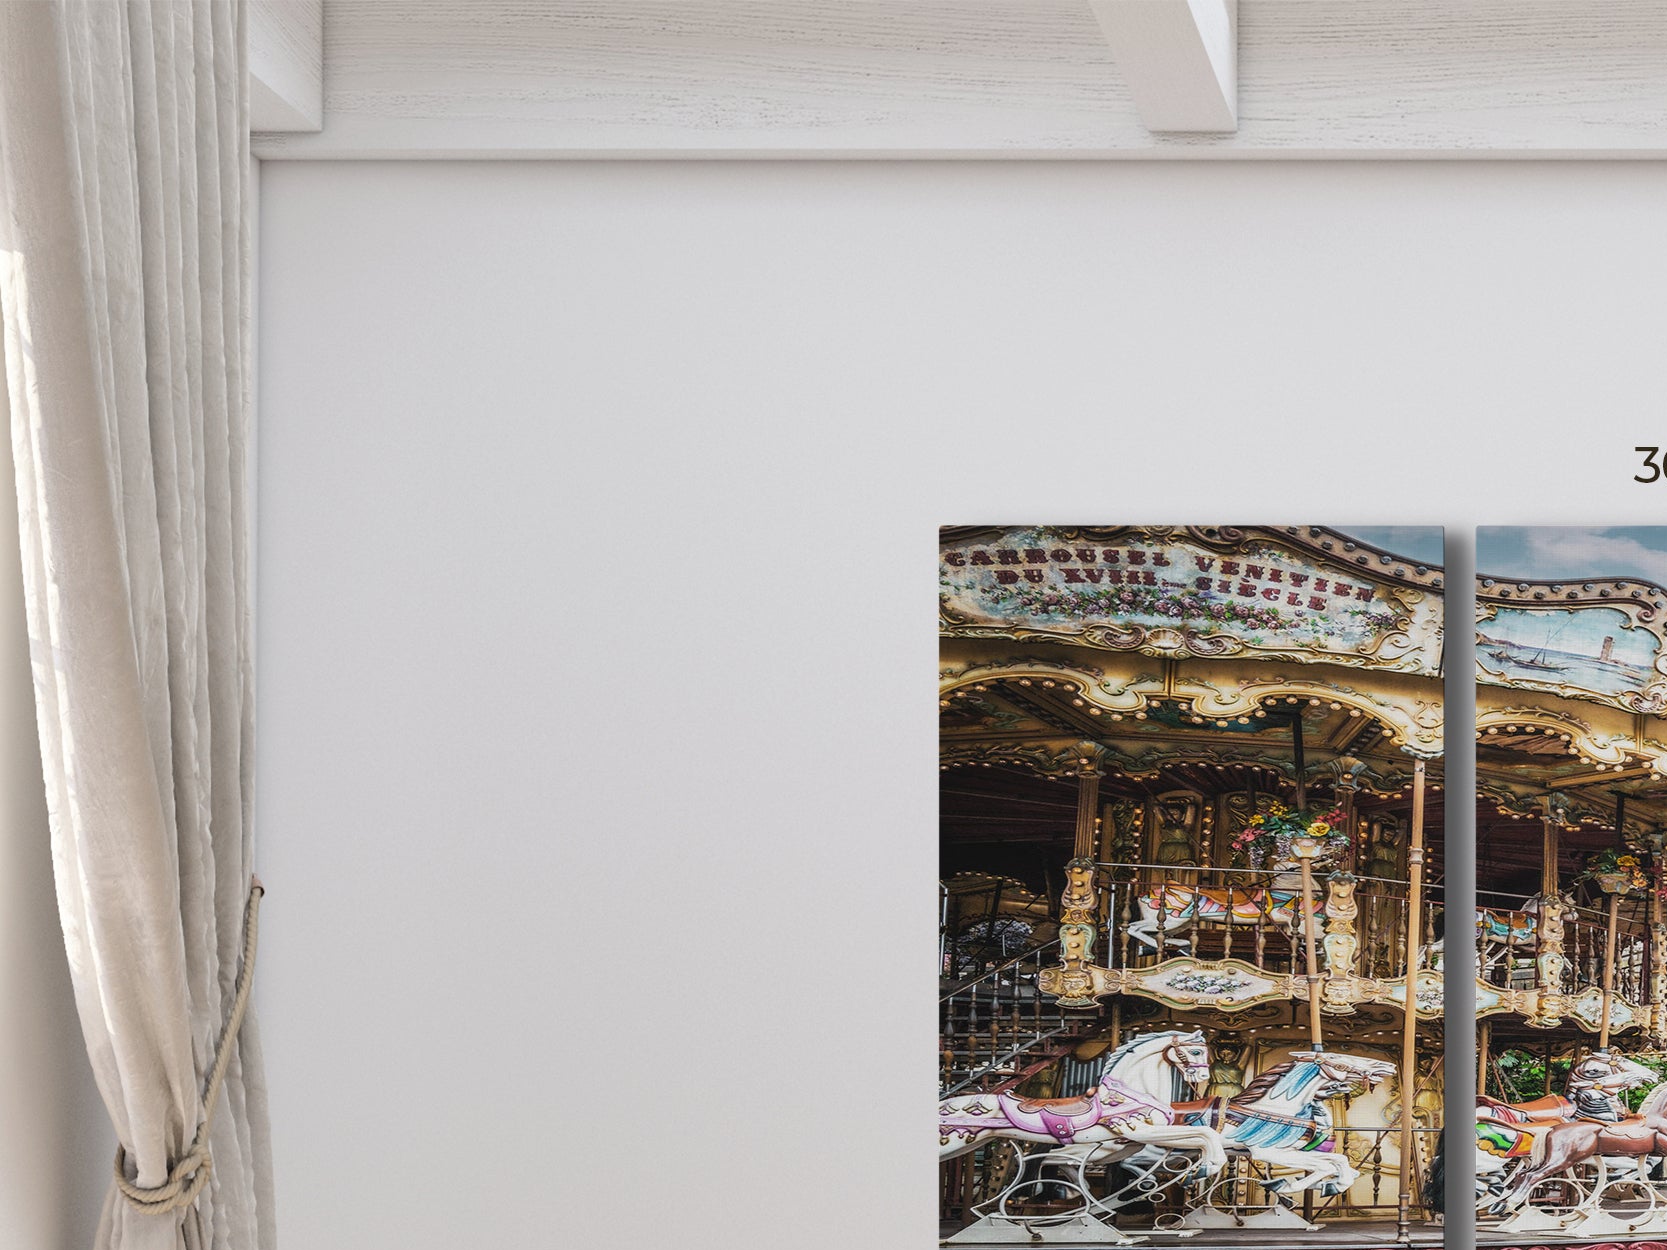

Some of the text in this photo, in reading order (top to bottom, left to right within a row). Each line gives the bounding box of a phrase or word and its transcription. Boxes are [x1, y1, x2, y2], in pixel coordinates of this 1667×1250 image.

[944, 548, 1376, 603] CARROUSEL VENITIEN
[994, 569, 1045, 585] DU
